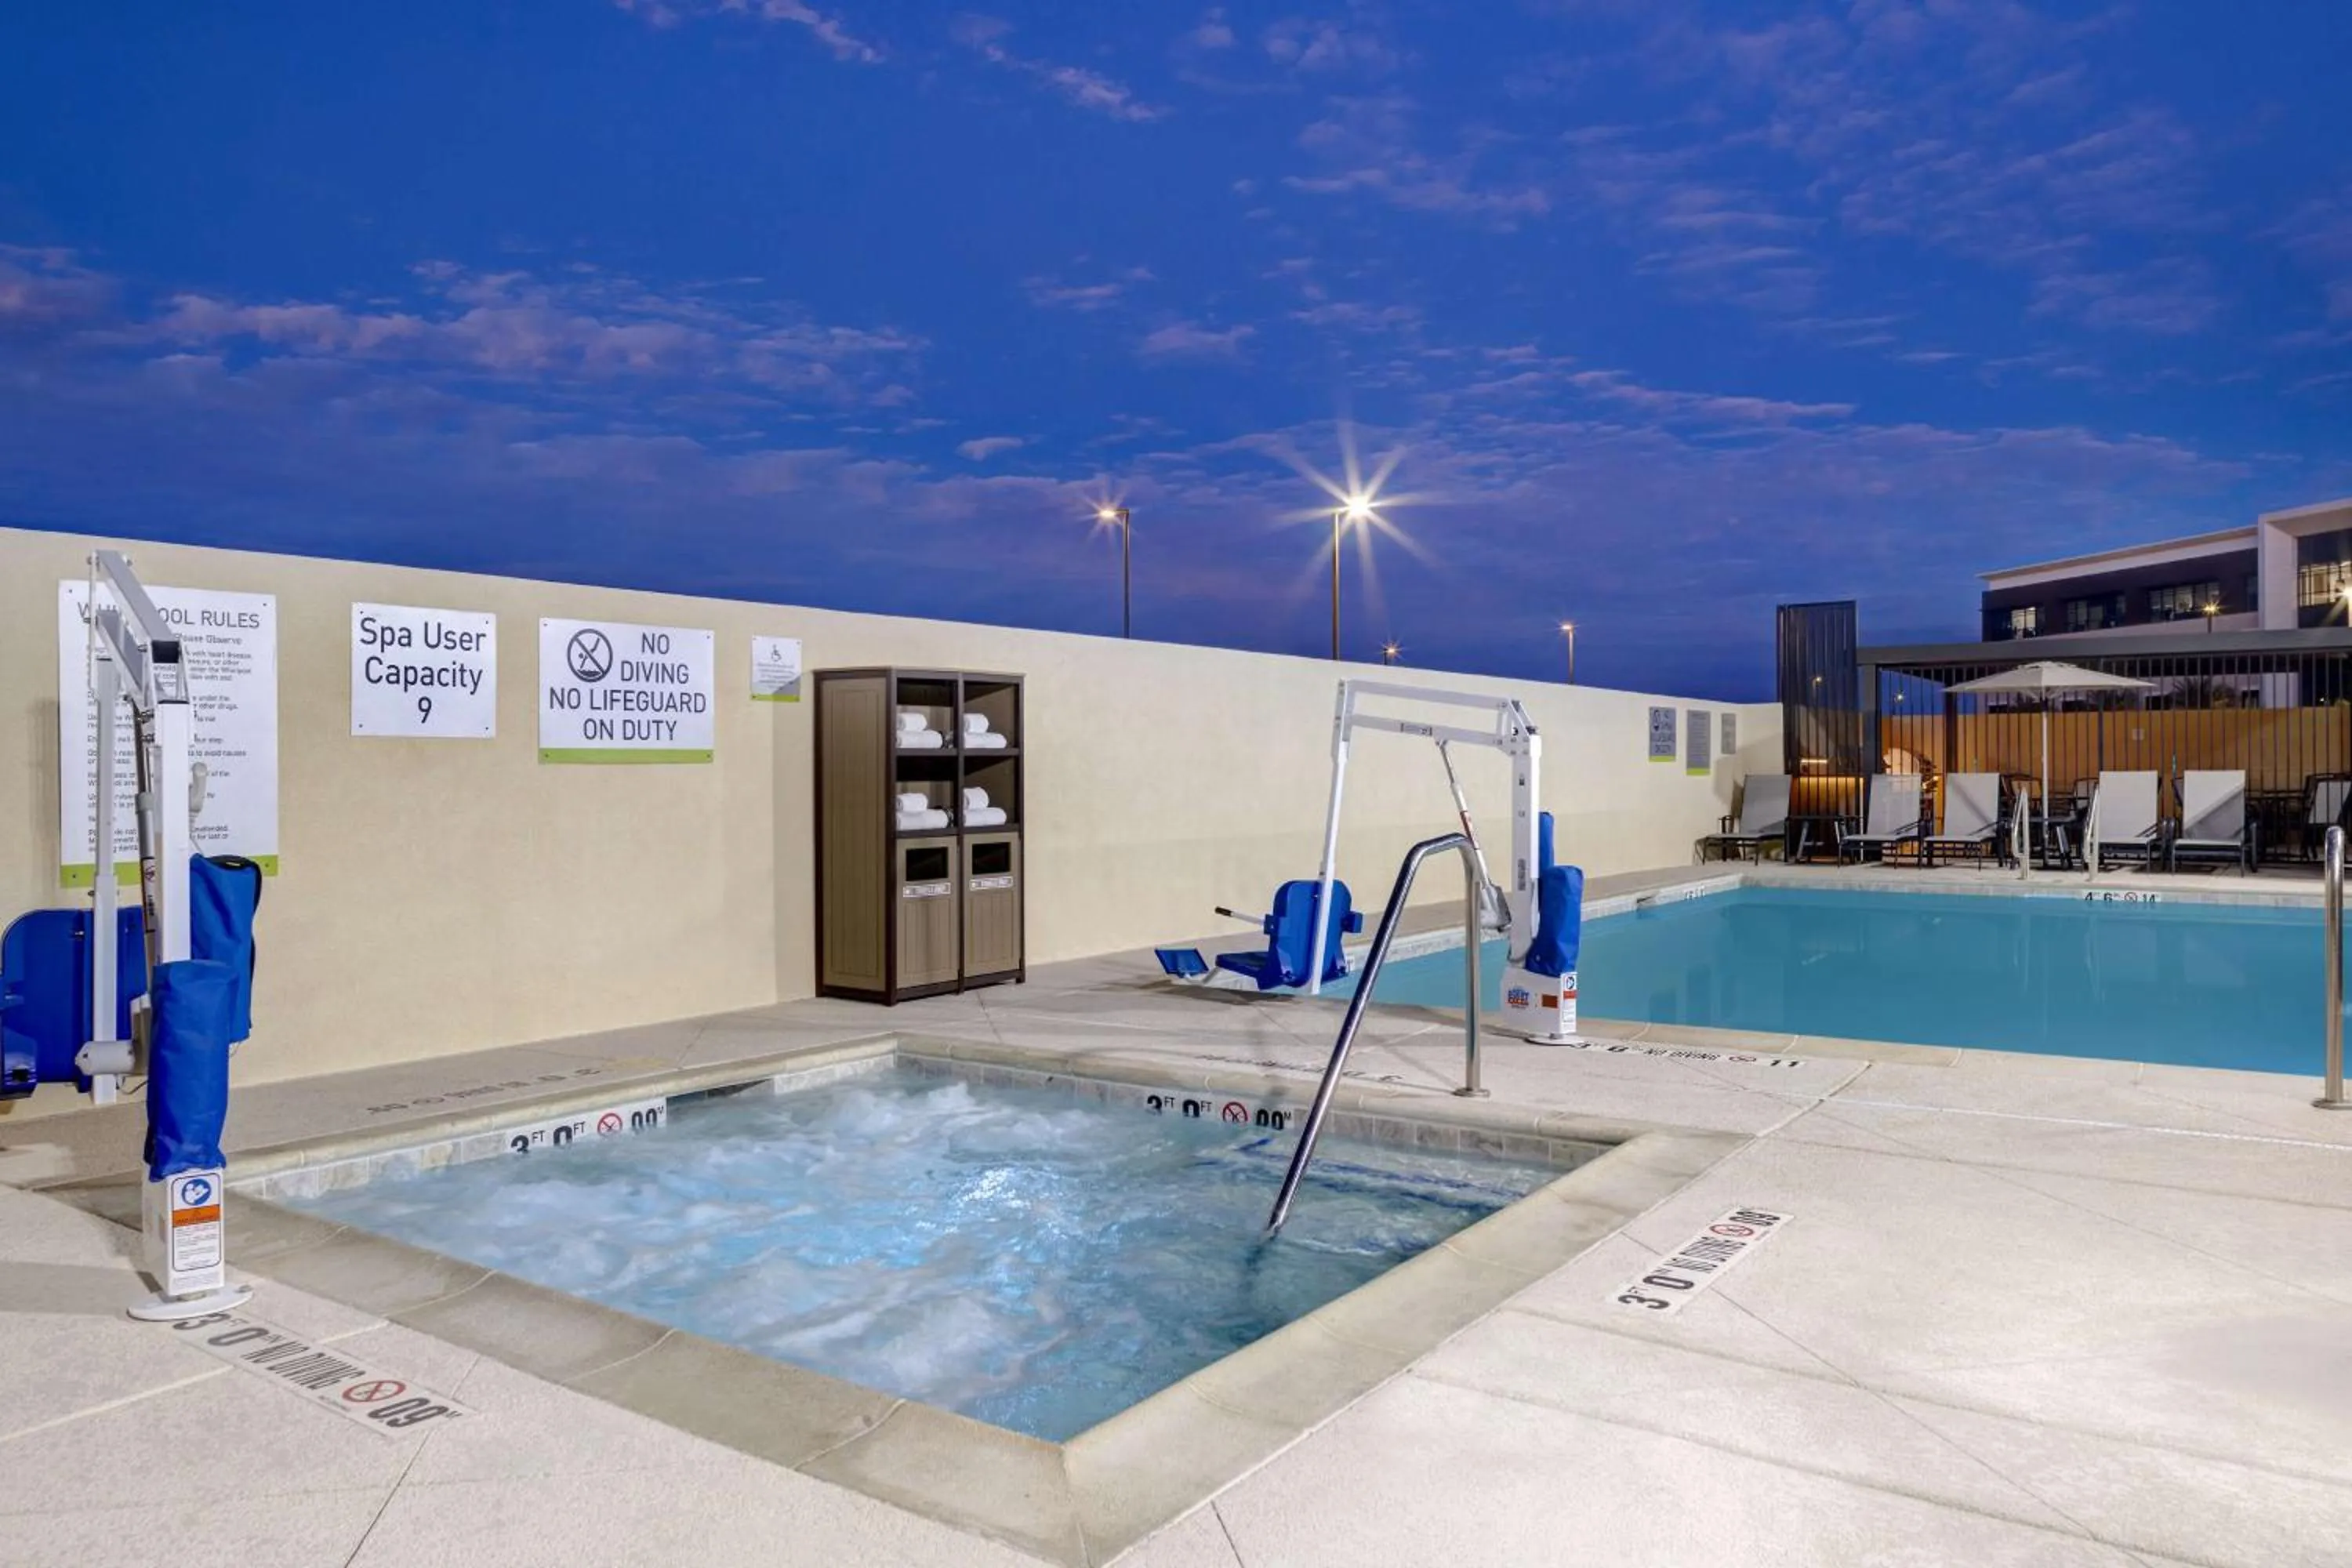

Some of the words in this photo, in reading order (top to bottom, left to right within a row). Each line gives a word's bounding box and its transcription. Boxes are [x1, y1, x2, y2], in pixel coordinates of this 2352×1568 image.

[201, 610, 260, 628] RULES
[359, 617, 412, 653] Spa
[424, 621, 487, 652] User
[641, 632, 670, 655] NO
[365, 655, 484, 695] Capacity
[621, 659, 690, 684] DIVING
[417, 696, 433, 724] 9
[550, 688, 581, 710] NO
[590, 689, 706, 713] LIFEGUARD
[583, 719, 614, 741] ON
[622, 720, 677, 741] DUTY
[1163, 1097, 1175, 1108] FT
[532, 1130, 546, 1142] FT
[573, 1121, 586, 1136] FT
[1679, 1236, 1748, 1262] DIVING
[1642, 1276, 1694, 1290] 0
[1617, 1294, 1671, 1310] 3
[207, 1327, 270, 1347] 0
[239, 1341, 310, 1364] NO
[267, 1352, 366, 1390] DIVING
